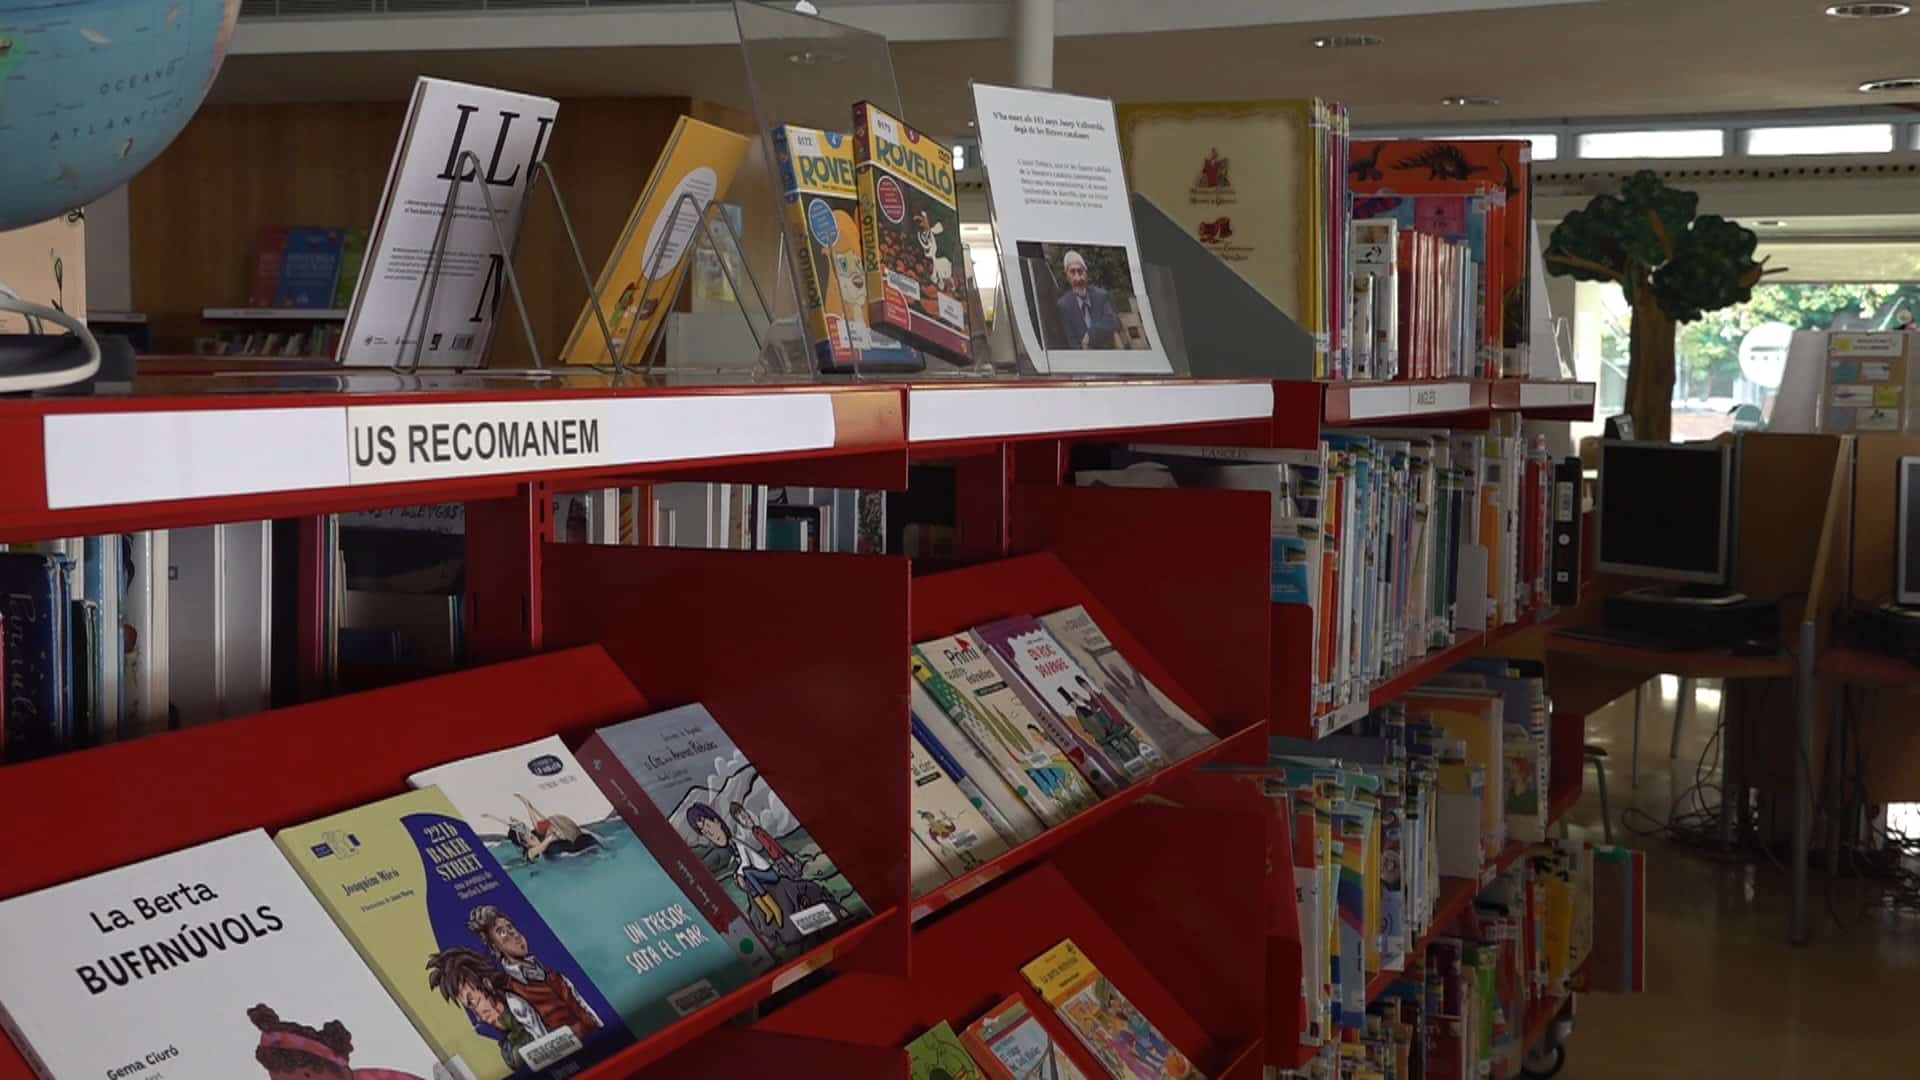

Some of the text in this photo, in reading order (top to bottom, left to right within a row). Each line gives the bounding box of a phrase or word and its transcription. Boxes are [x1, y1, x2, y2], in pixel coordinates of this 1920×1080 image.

[876, 136, 952, 195] ROVELLÓ
[354, 419, 599, 467] US RECOMANEM
[424, 822, 458, 843] 221b
[425, 837, 472, 864] BAKER
[341, 875, 380, 896] Joaquim
[435, 853, 483, 882] STREET
[89, 882, 219, 934] La Berta
[623, 903, 693, 945] UN TRESOR
[75, 905, 284, 995] BUFANÚVOLS
[625, 924, 711, 975] SOTA EL MAR
[106, 1060, 146, 1080] Gema
[145, 1043, 179, 1065] Ciuró
